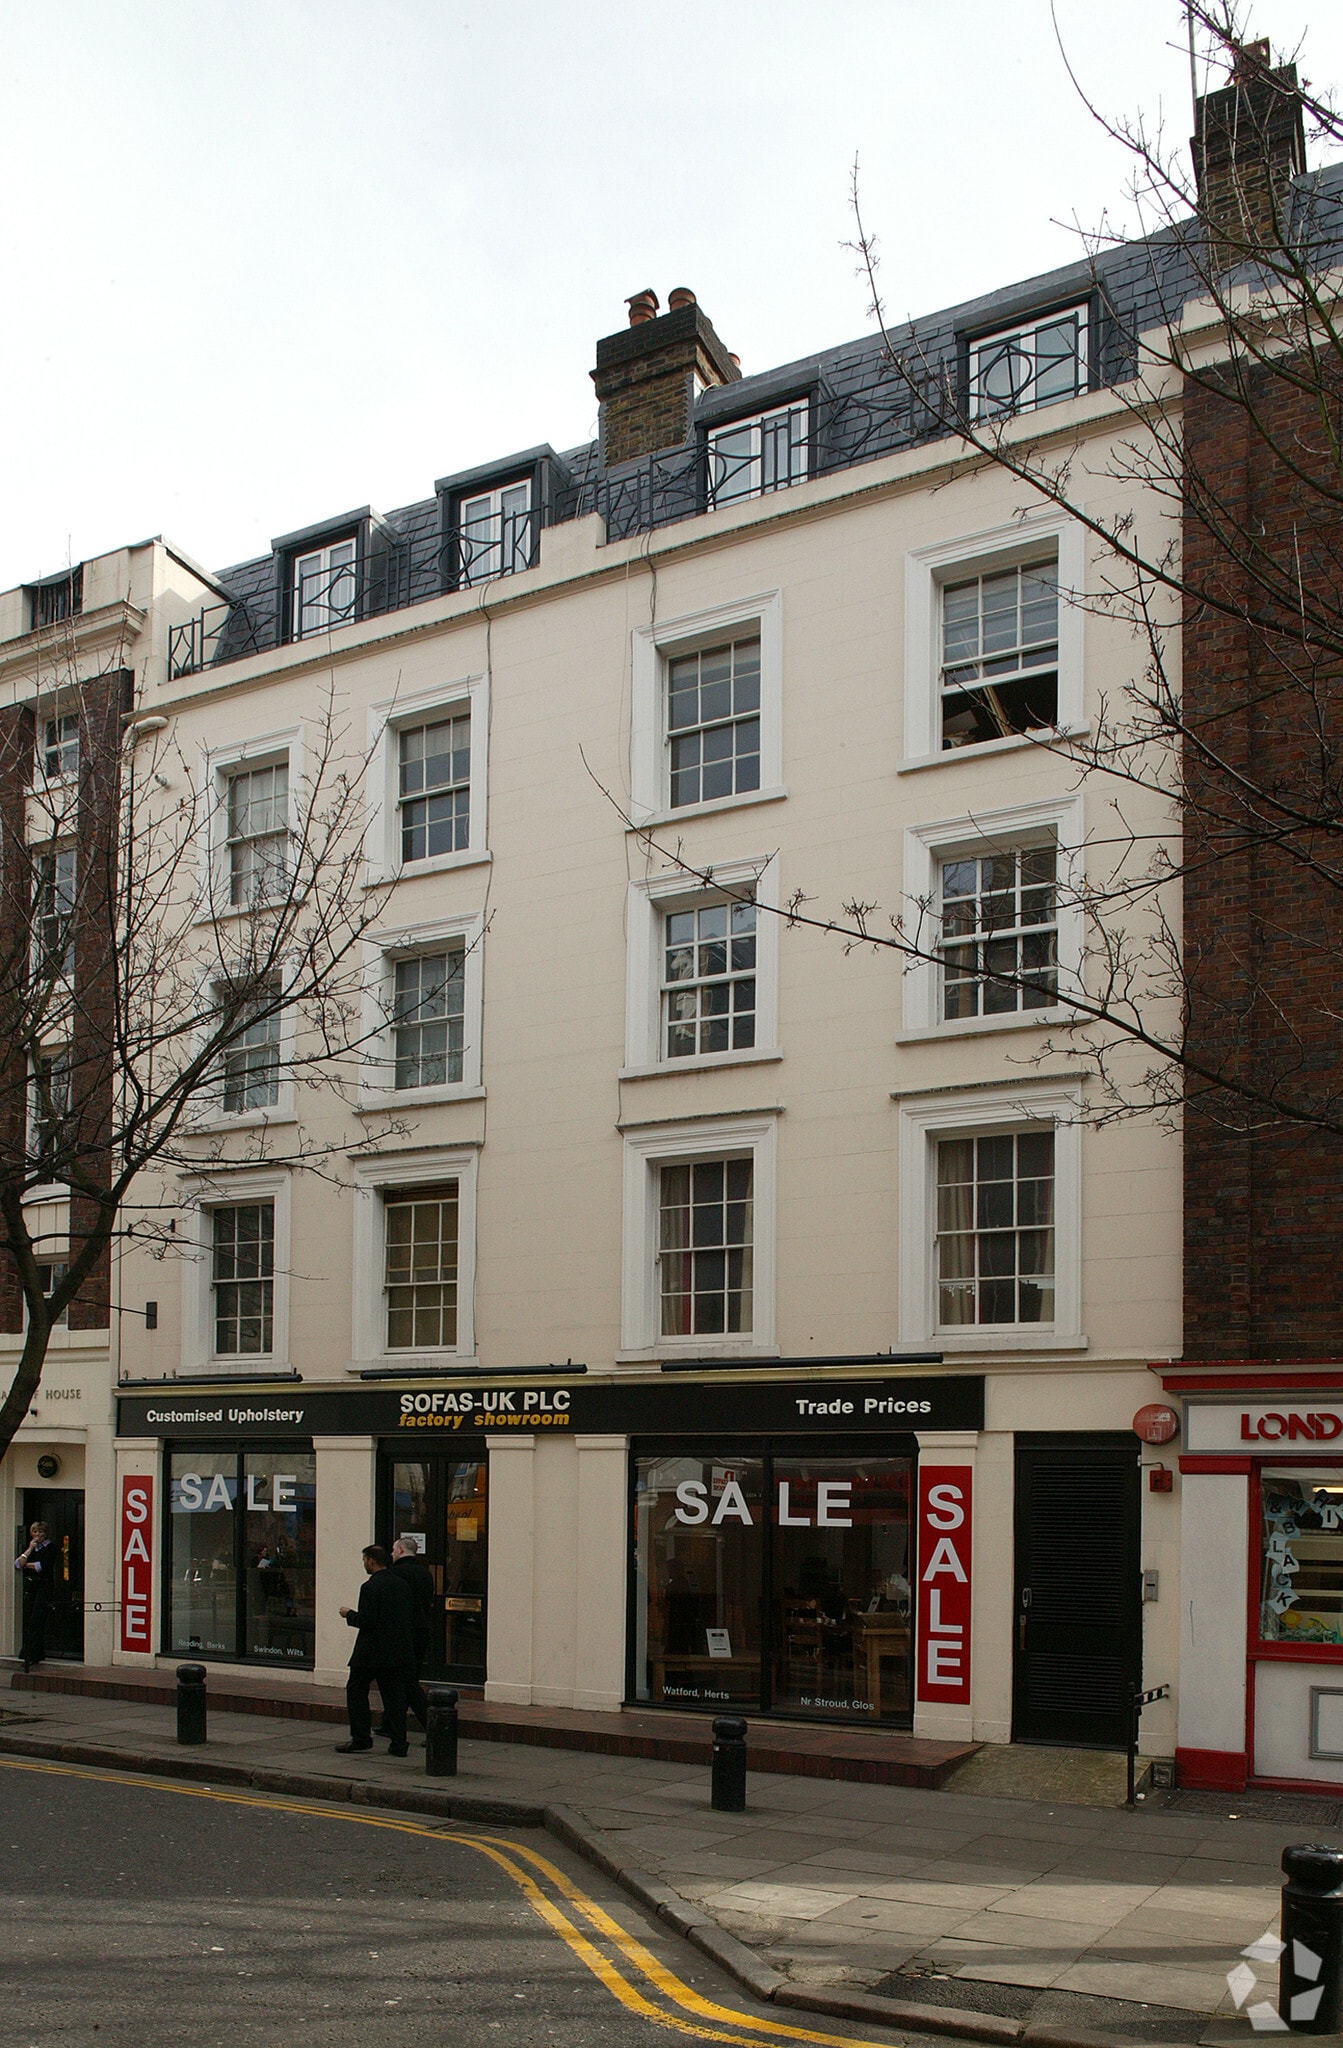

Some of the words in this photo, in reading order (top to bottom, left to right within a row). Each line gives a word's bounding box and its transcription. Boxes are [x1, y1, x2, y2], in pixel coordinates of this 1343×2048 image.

[45, 1389, 82, 1400] HOUSE
[400, 1392, 516, 1413] SOFAS-UK
[523, 1391, 571, 1411] PLC
[795, 1399, 854, 1415] Trade
[864, 1397, 932, 1414] Prices
[146, 1409, 223, 1422] Customised
[228, 1408, 305, 1424] Upholstery
[399, 1413, 464, 1429] factory
[474, 1412, 570, 1426] showroom
[1240, 1412, 1343, 1440] LOND
[179, 1473, 298, 1512] SALE
[674, 1480, 853, 1527] SALE
[123, 1489, 150, 1639] SALE
[923, 1484, 968, 1686] SALE
[206, 1641, 226, 1650] Berks
[286, 1647, 305, 1657] Wilts
[662, 1686, 700, 1699] Watford,
[704, 1689, 730, 1700] Herts
[800, 1697, 812, 1706] Nr
[814, 1697, 850, 1710] Stroud,
[852, 1699, 875, 1711] Glos
